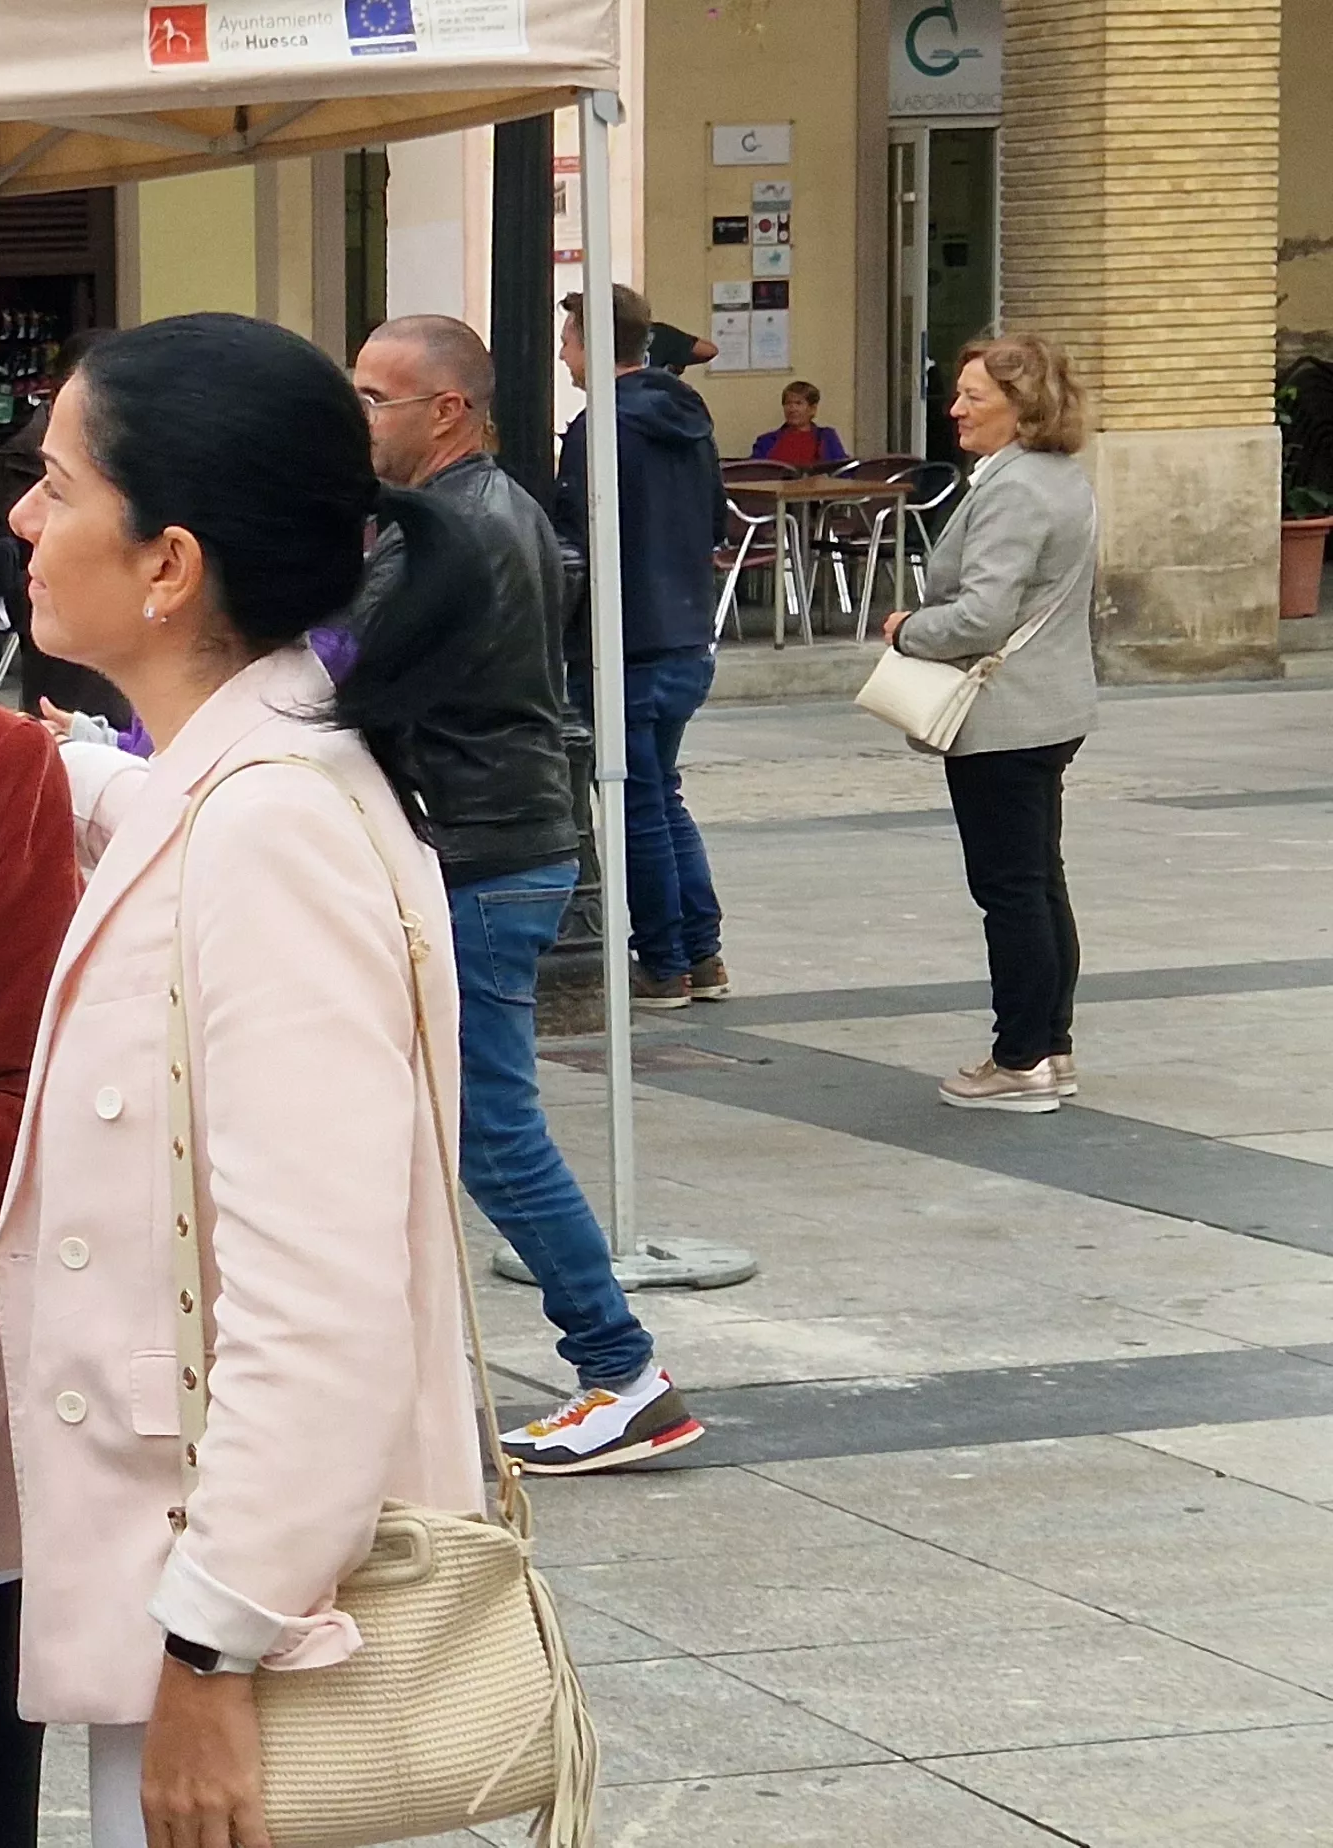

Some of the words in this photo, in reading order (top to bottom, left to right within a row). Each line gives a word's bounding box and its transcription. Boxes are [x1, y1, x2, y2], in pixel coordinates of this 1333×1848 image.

[218, 12, 333, 33] Ayuntamiento
[220, 37, 239, 51] de
[245, 35, 309, 50] Huesca
